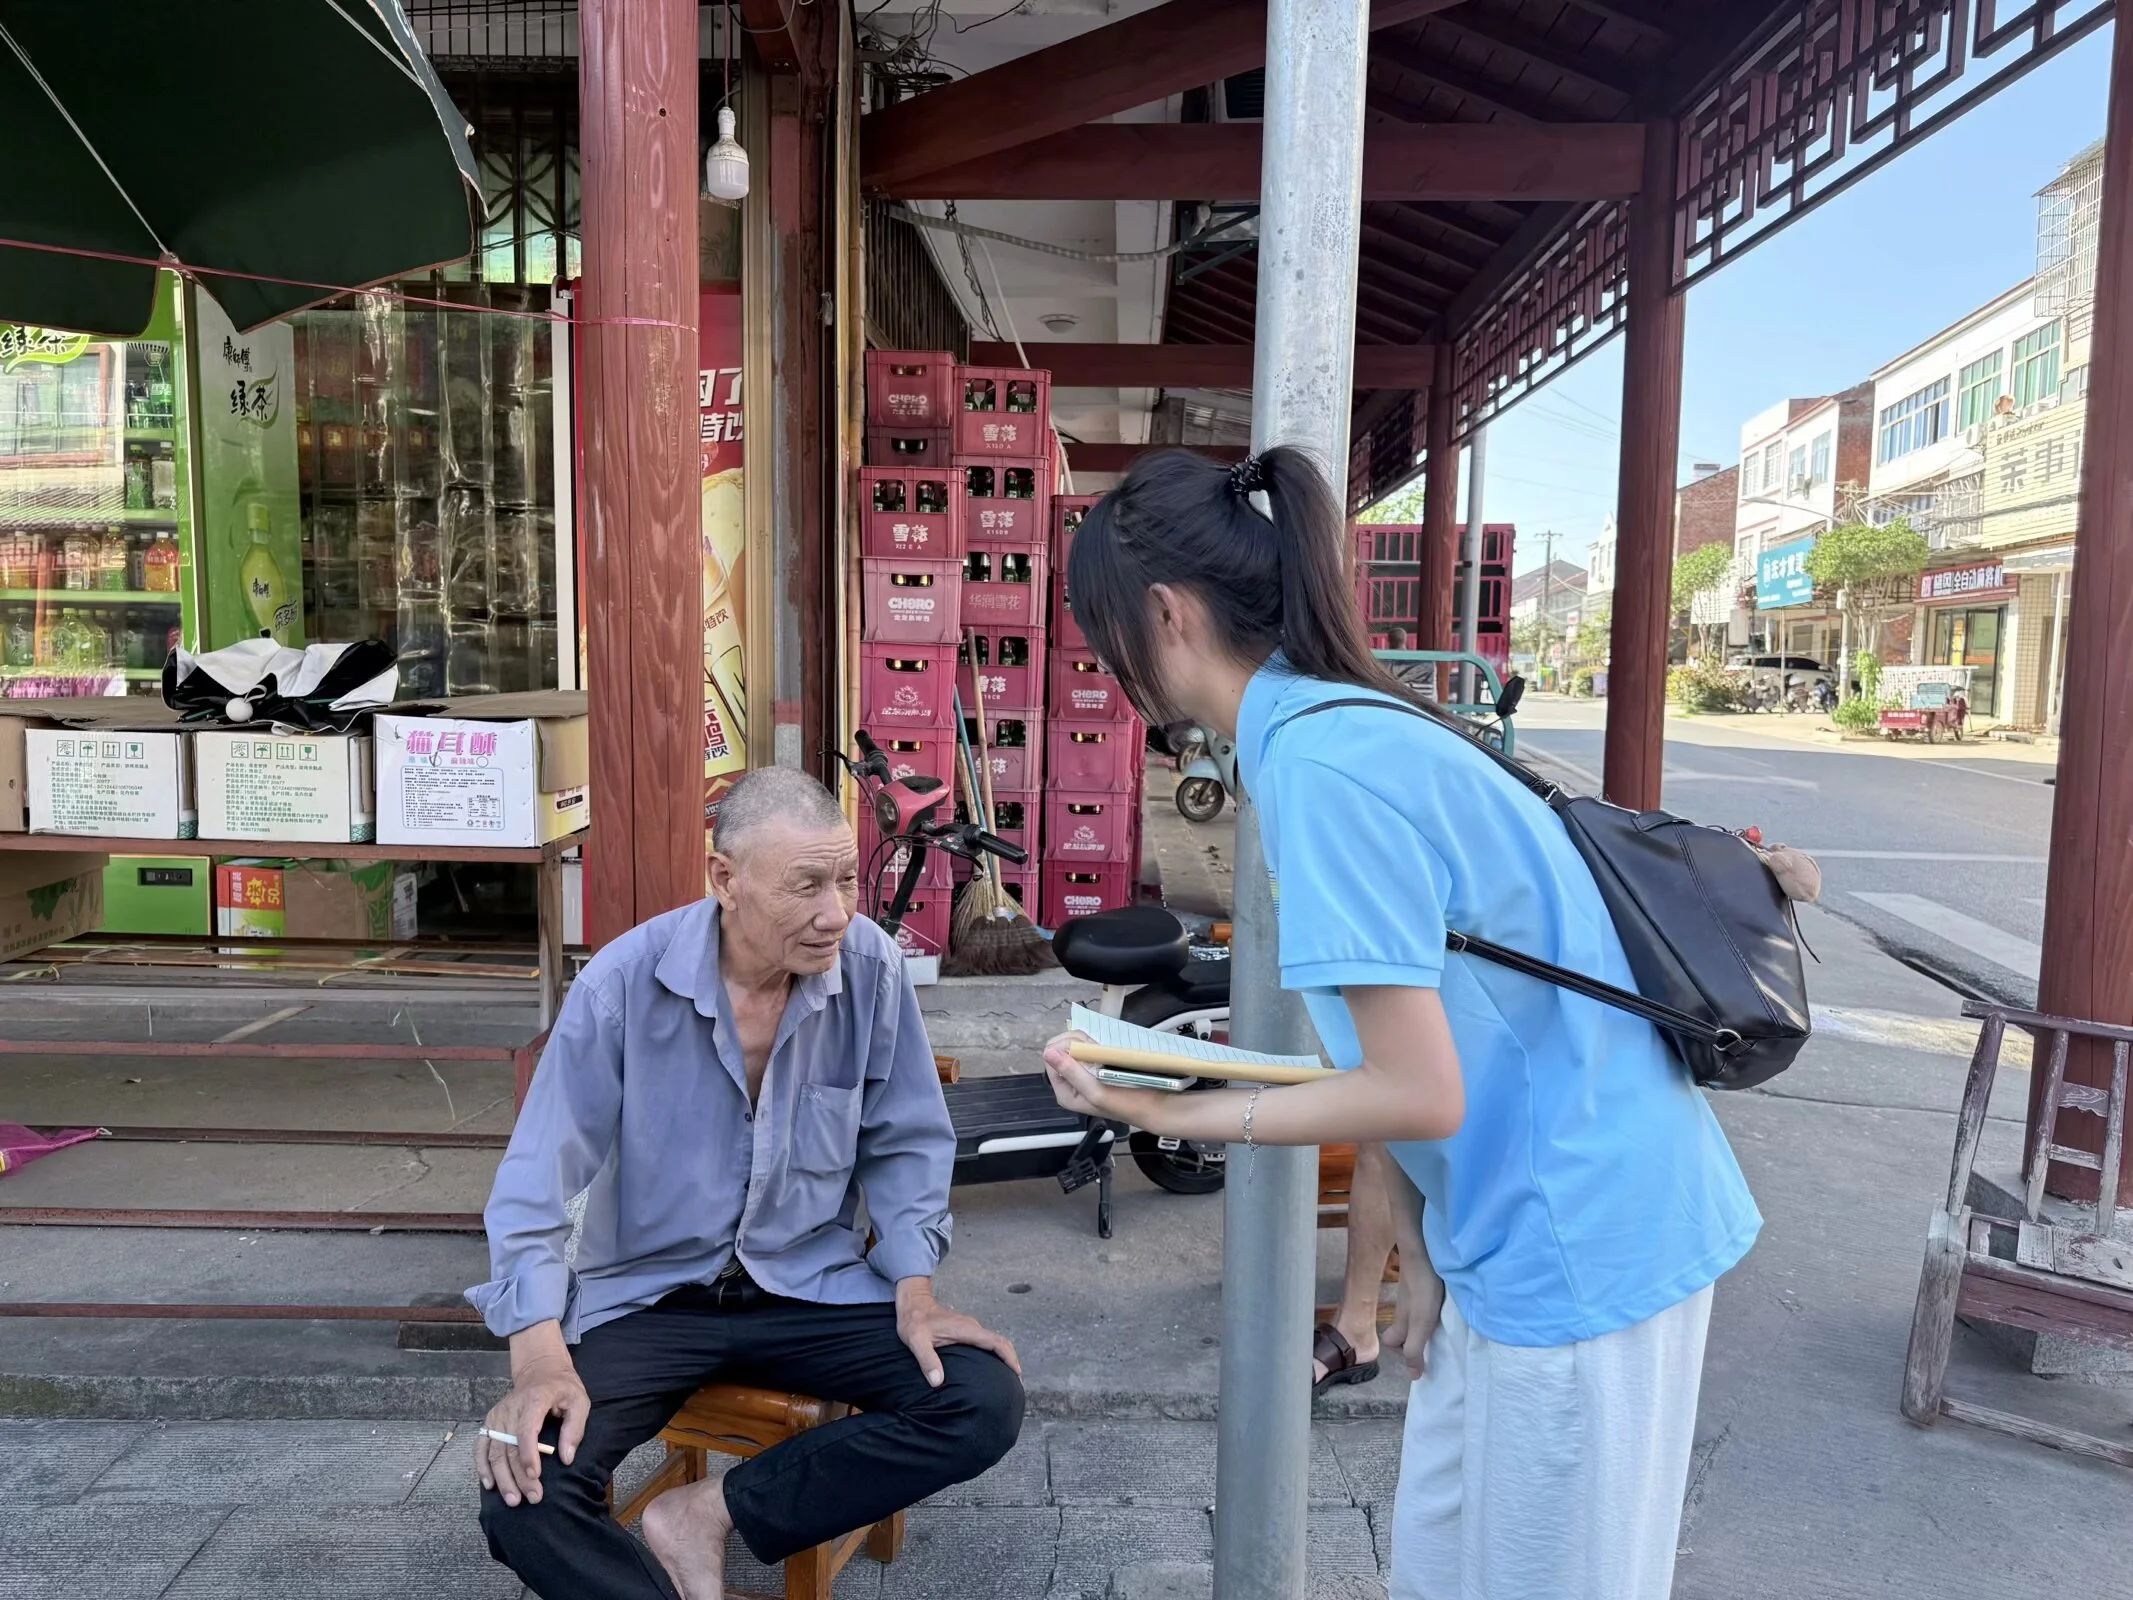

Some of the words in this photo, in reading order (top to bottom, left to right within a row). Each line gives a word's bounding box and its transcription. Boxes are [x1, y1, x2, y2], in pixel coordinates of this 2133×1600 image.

[230, 380, 269, 421] 绿茶
[983, 424, 1017, 442] 雪花
[980, 511, 1014, 528] 雪花
[892, 523, 928, 543] 雪花
[704, 607, 730, 632] 特饮
[406, 730, 498, 756] 猫耳酥
